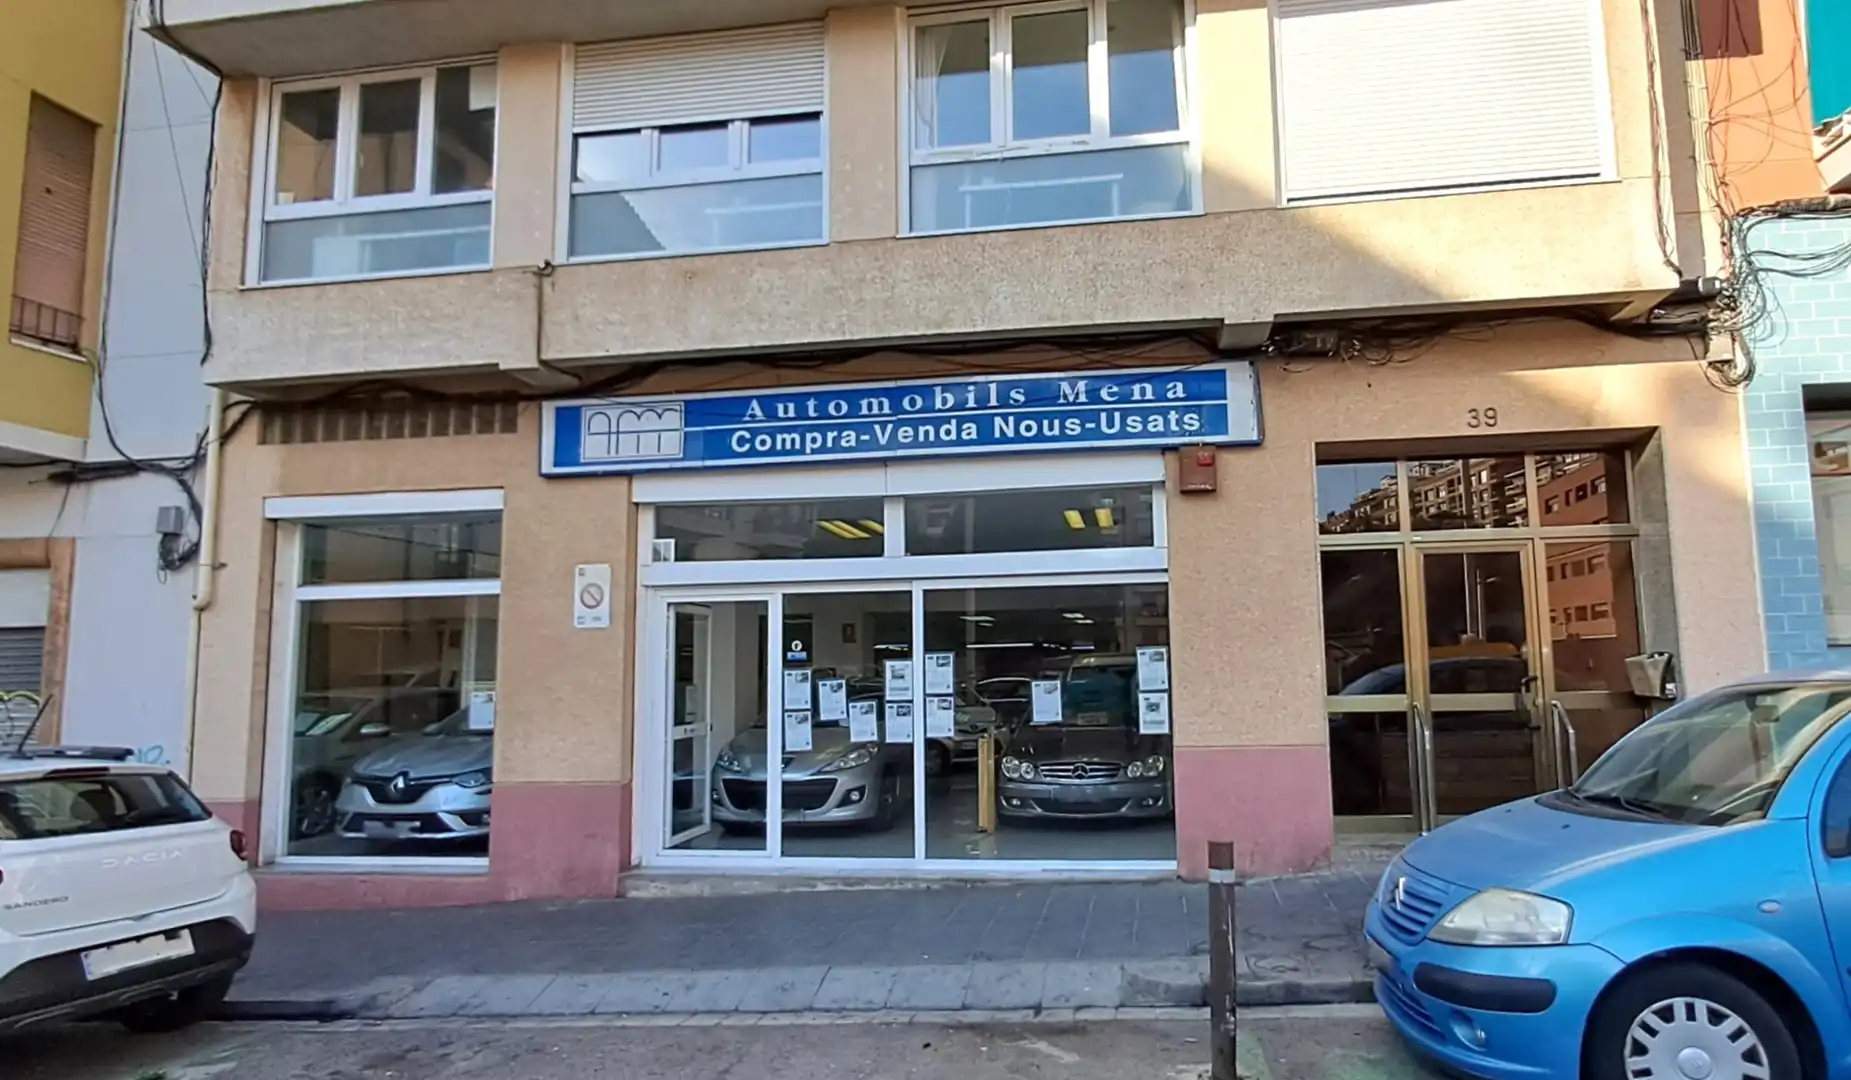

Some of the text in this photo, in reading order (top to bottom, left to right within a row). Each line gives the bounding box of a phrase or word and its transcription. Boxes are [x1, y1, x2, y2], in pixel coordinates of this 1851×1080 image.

[742, 379, 1187, 421] Automobils Mena
[1467, 407, 1498, 429] 39
[731, 409, 1201, 455] Compra-Venda Nous-Usats
[101, 849, 184, 869] DACIA
[4, 895, 70, 911] SANDERO
